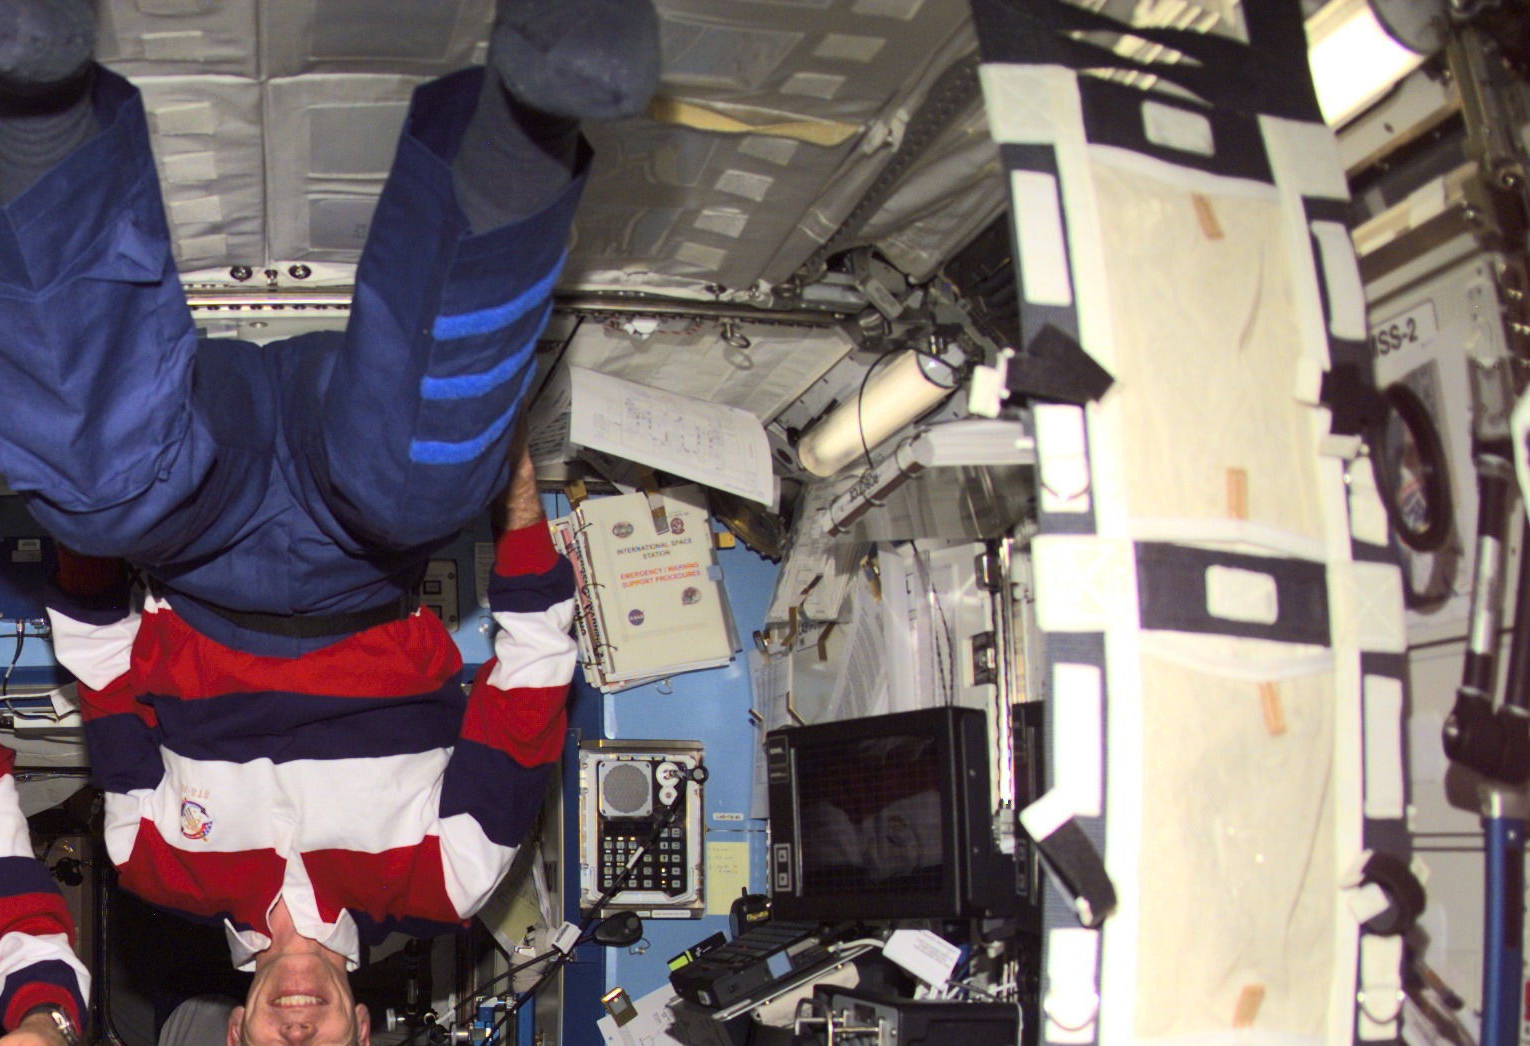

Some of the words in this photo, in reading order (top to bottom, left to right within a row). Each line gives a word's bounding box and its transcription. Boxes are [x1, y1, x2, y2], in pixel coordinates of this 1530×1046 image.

[1370, 316, 1418, 355] SS-2
[616, 542, 670, 555] INTERNATIONAL
[670, 538, 692, 546] SPACE
[642, 551, 671, 560] STATION
[620, 568, 663, 580] EMERGENCY
[622, 578, 654, 588] SUPPORT
[655, 570, 701, 582] PROCEDURES
